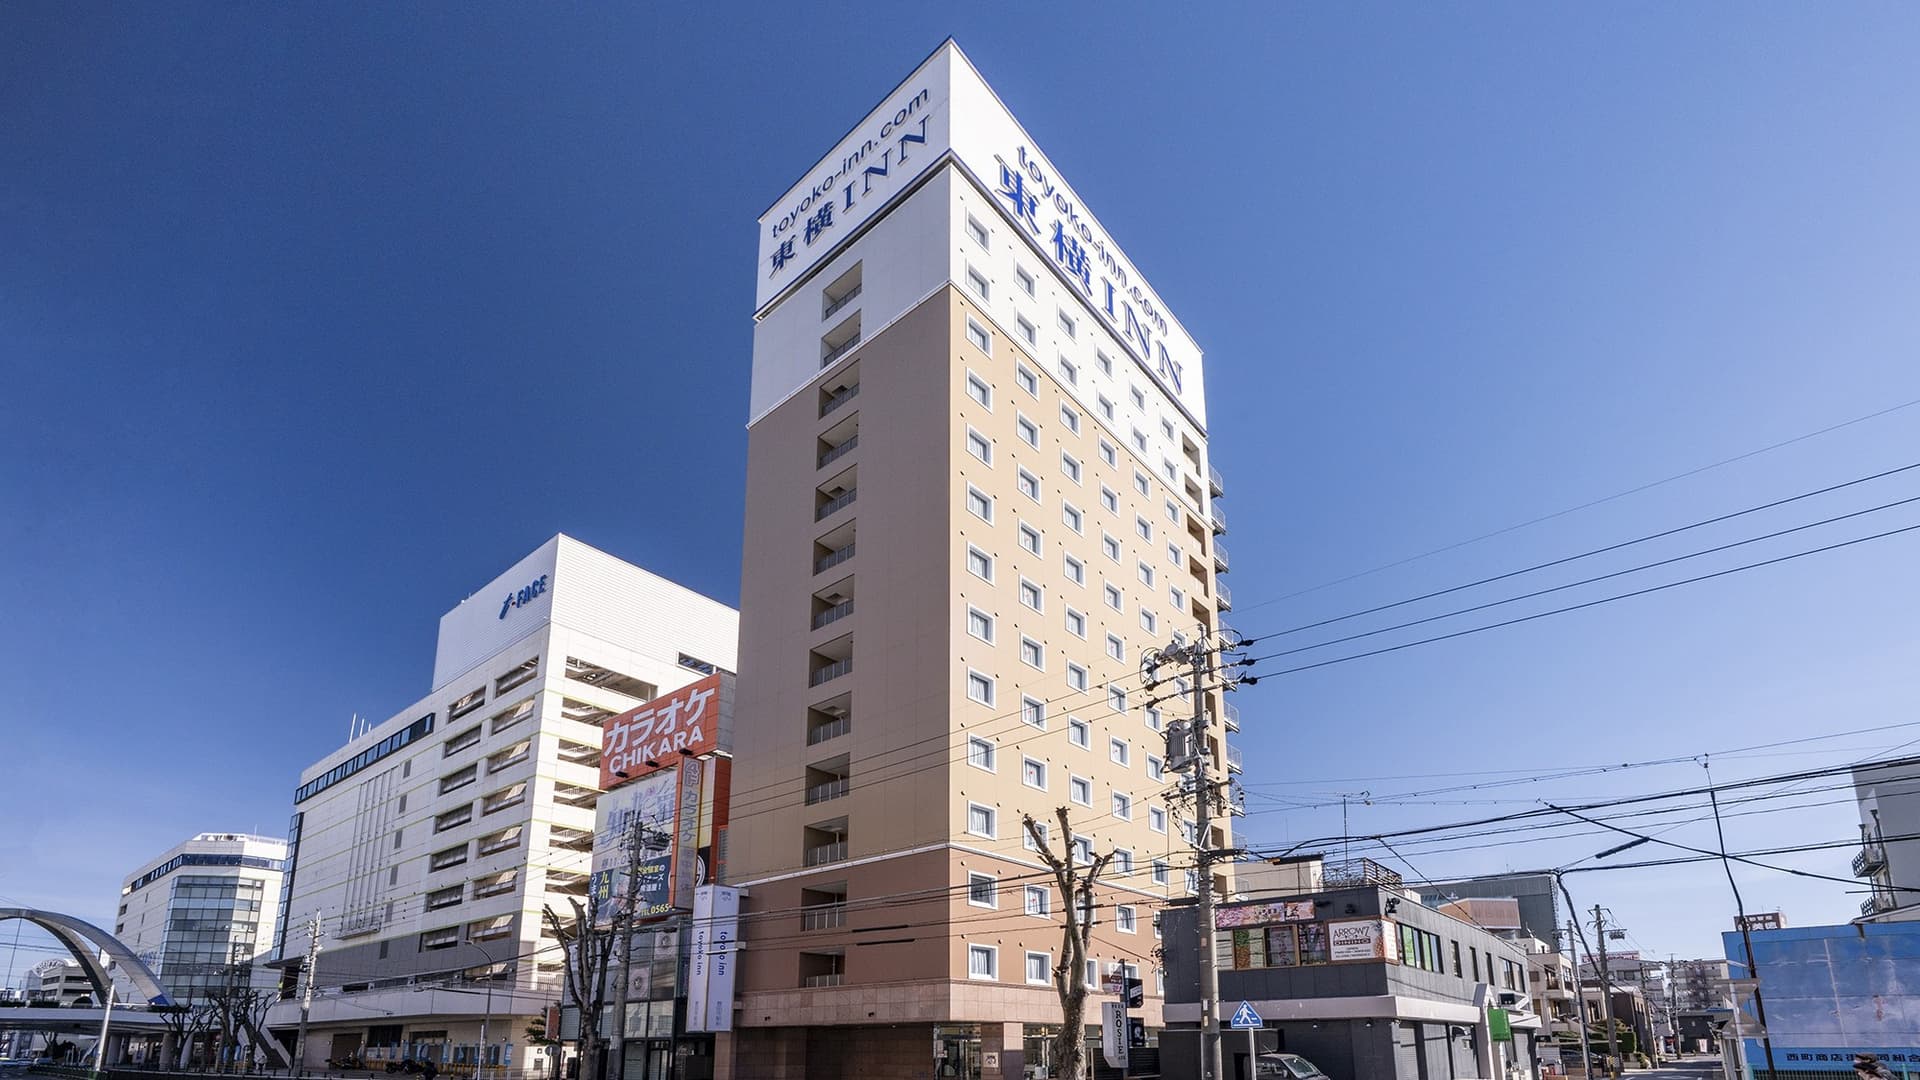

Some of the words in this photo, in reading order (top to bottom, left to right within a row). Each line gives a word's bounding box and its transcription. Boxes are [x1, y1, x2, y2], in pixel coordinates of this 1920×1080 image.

[772, 88, 928, 238] toyoko-inn.com
[1017, 145, 1168, 338] toyoko-inn.com
[603, 688, 715, 757] カラオケ
[609, 725, 704, 774] CHIKARA
[599, 871, 609, 899] 九州
[718, 962, 727, 976] inn
[1115, 1010, 1124, 1055] ROSIE
